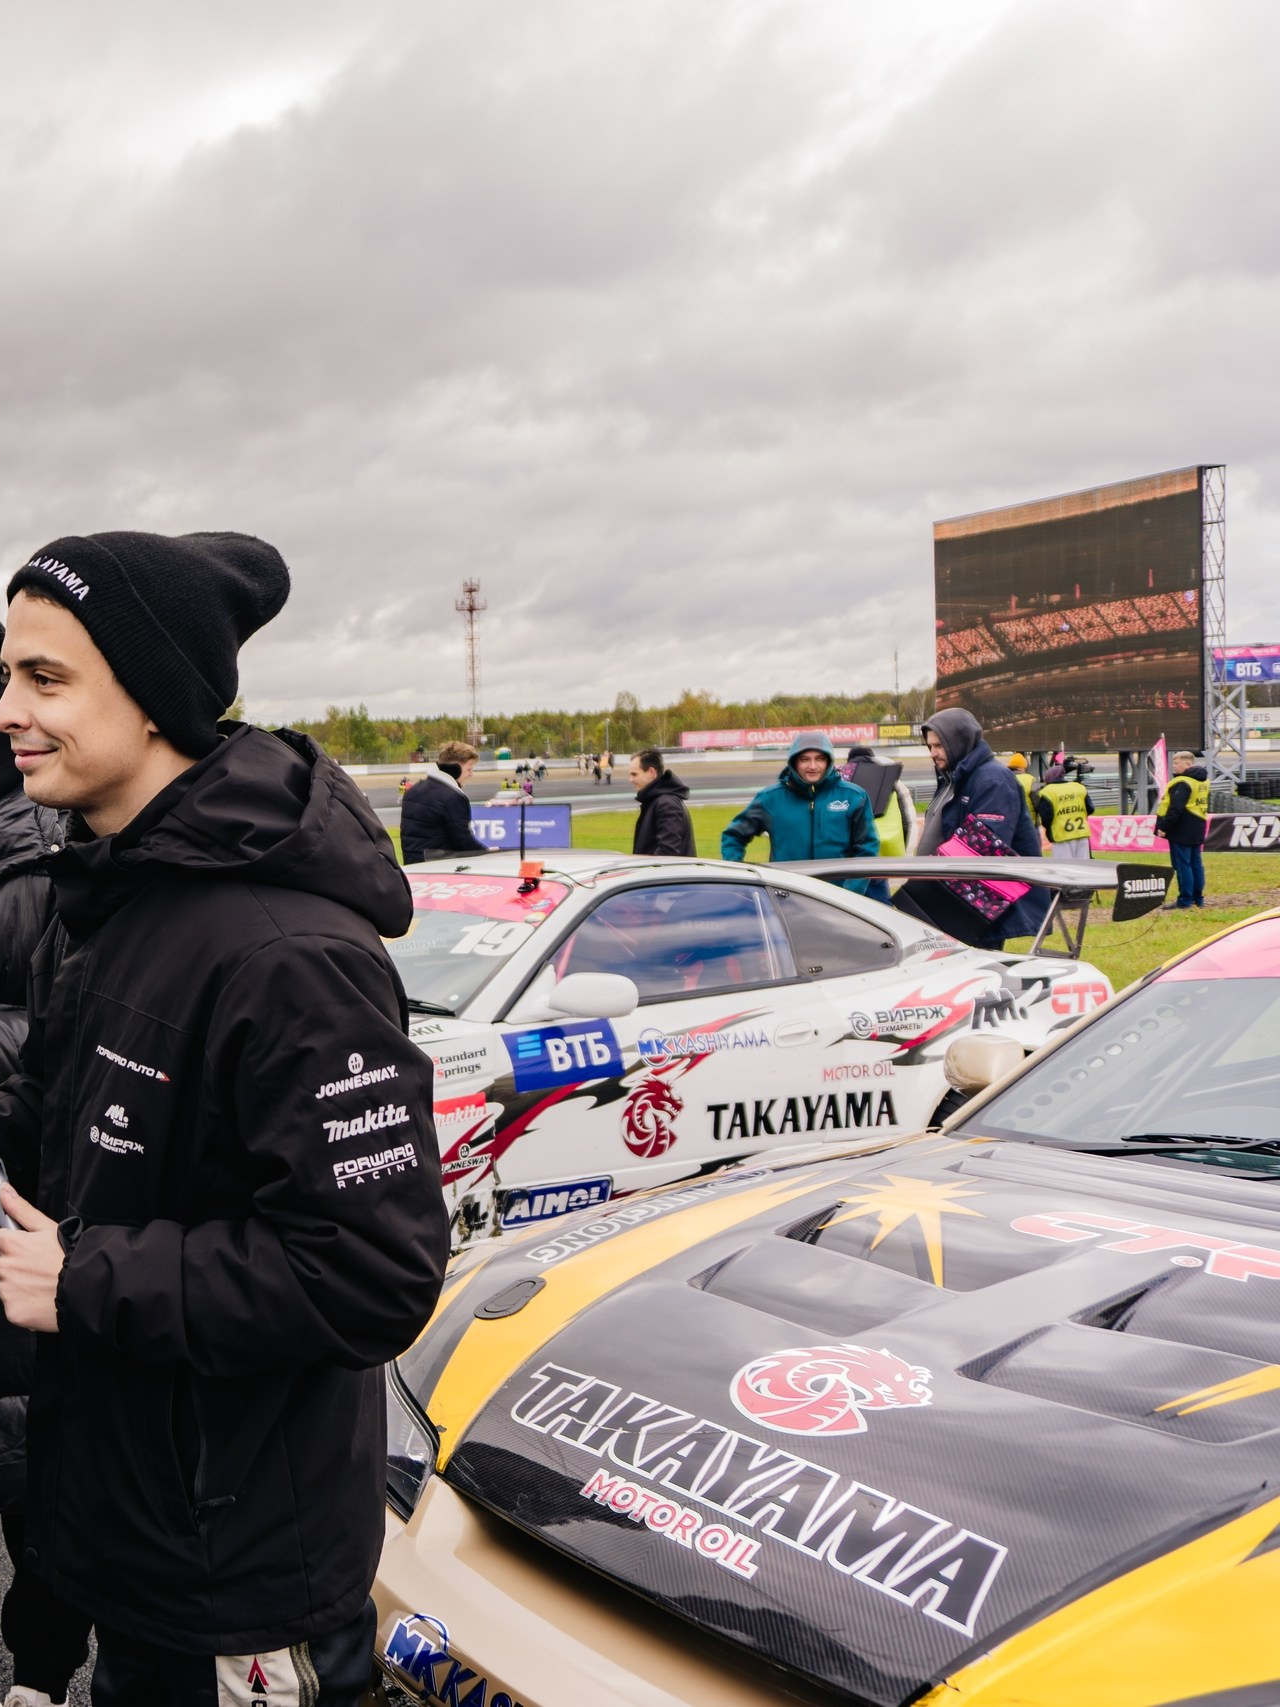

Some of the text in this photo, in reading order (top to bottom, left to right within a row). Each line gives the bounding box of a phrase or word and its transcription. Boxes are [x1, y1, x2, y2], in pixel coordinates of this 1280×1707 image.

[1235, 662, 1262, 678] ВТБ
[818, 726, 874, 739] uto.ru
[1056, 805, 1085, 816] MEDIA
[1064, 816, 1085, 832] 62
[1099, 817, 1157, 847] RDS
[1229, 816, 1280, 847] RD
[1123, 877, 1166, 893] SIRUDA
[449, 921, 535, 956] 19
[875, 1005, 946, 1024] ВИРАЖ
[877, 1022, 923, 1034] ТЕХМАРКЕТЫ
[545, 1031, 612, 1073] ВТБ
[670, 1029, 770, 1054] KASHIYAMA
[95, 1044, 156, 1077] FORWARD AUTO
[432, 1047, 487, 1066] Standard
[436, 1062, 482, 1079] Springs
[822, 1061, 896, 1082] MOTOR OIL
[706, 1090, 899, 1141] TAKAYAMA
[100, 1131, 145, 1154] ВИРАЖ
[332, 1142, 416, 1177] FORWARD
[336, 1158, 419, 1190] RACING
[504, 1186, 606, 1221] AIMOL
[510, 1362, 1008, 1638] TAKAYAMA
[579, 1468, 763, 1579] MOTOR OIL
